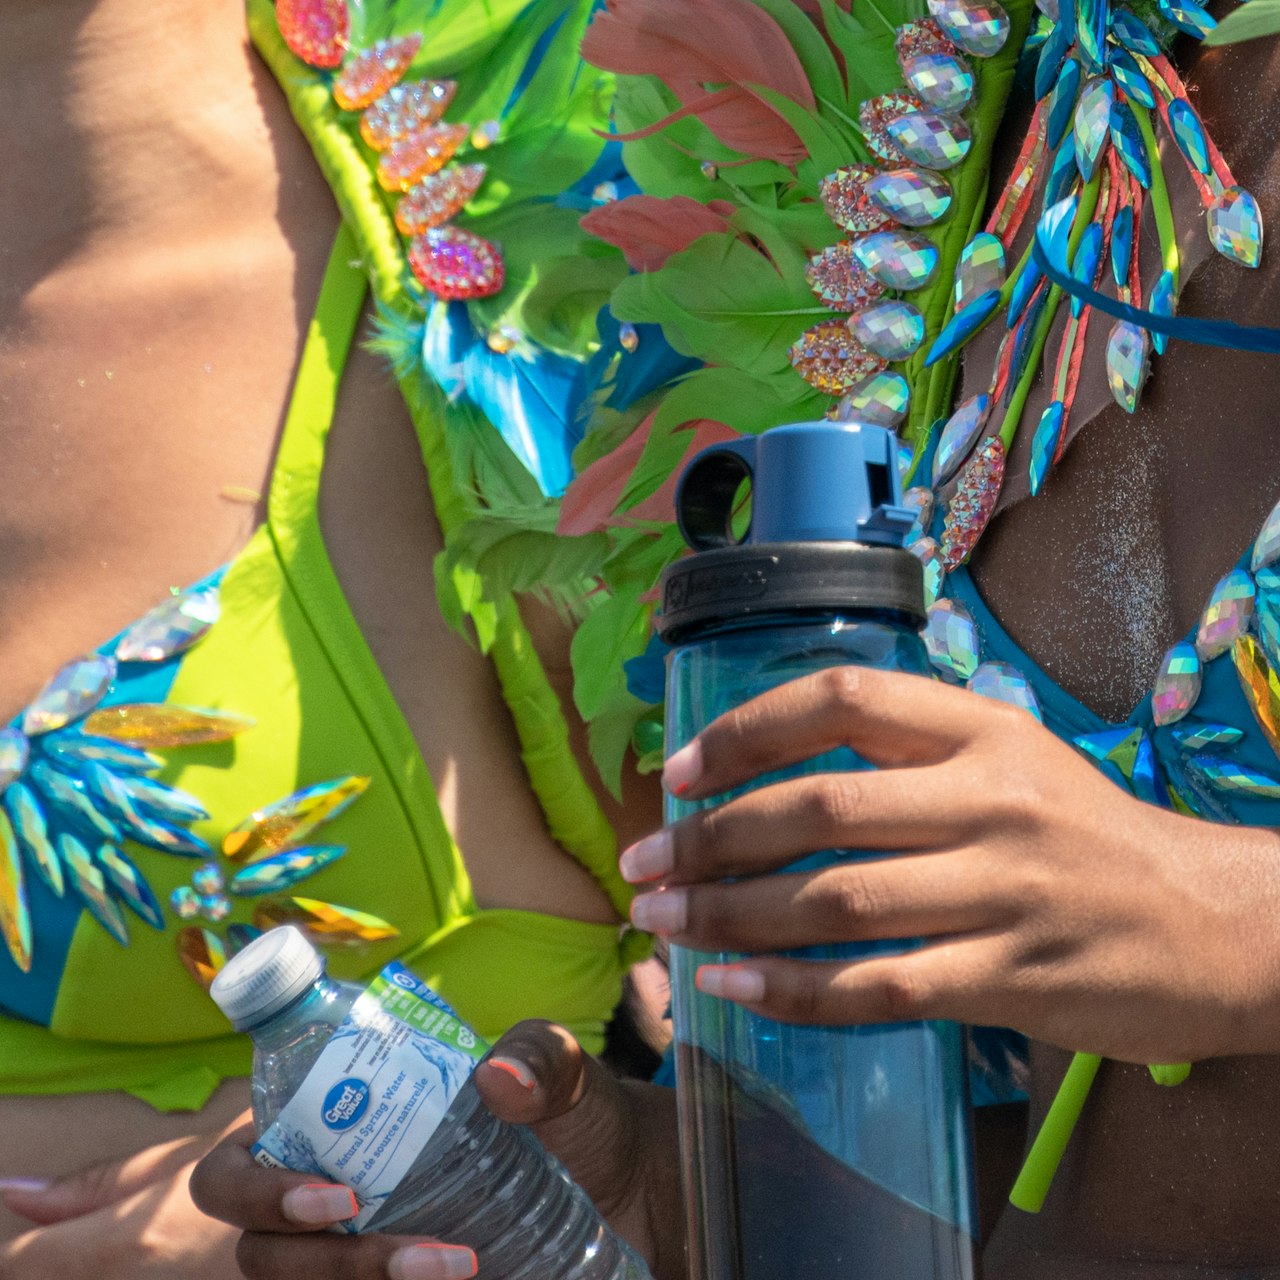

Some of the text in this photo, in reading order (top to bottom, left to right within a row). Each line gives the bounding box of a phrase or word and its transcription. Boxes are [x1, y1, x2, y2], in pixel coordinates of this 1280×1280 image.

[325, 1085, 357, 1123] Great
[335, 1070, 406, 1169] Natural Spring Water
[340, 1092, 364, 1121] Value
[350, 1078, 428, 1185] Eau de source naturelle
